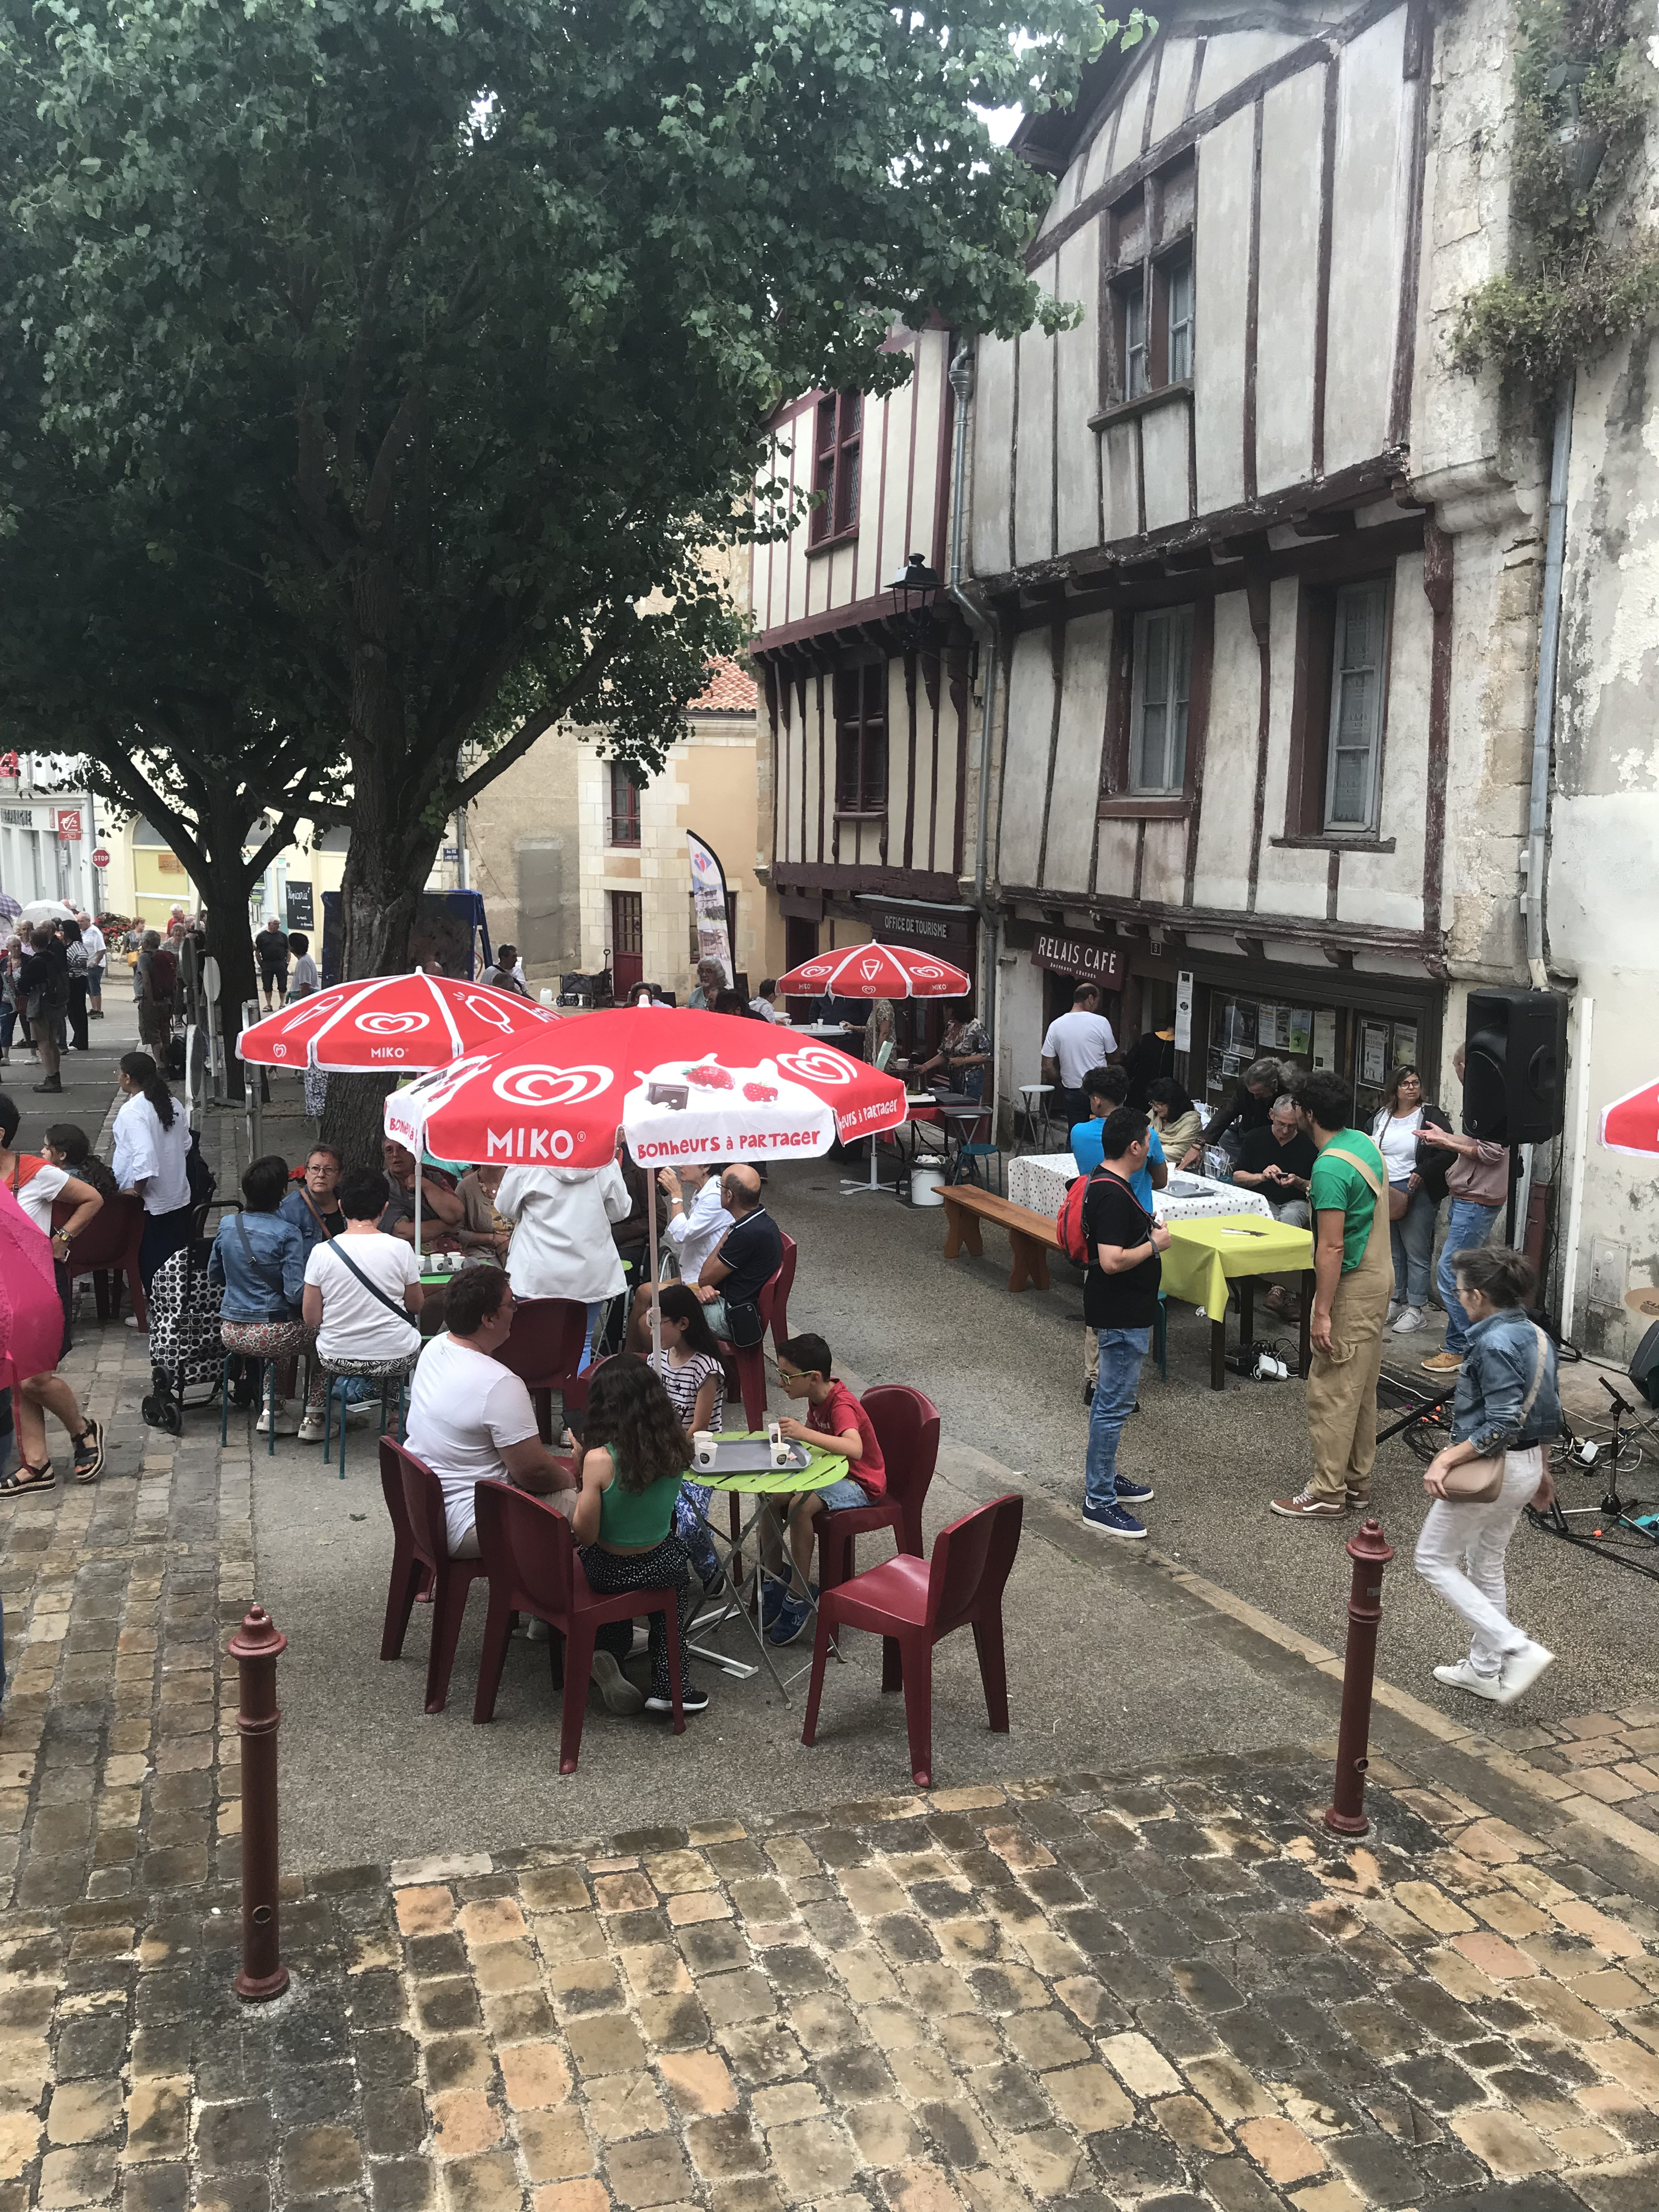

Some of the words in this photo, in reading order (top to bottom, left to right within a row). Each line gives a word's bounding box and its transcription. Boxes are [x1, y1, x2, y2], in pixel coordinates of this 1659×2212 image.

[884, 915, 905, 930] OFFICE
[906, 918, 914, 932] DE
[915, 919, 946, 938] TOURISME
[1038, 936, 1080, 964] RELAIS
[1085, 948, 1116, 973] CAFÉ
[858, 1109, 863, 1123] à
[726, 1136, 733, 1150] à
